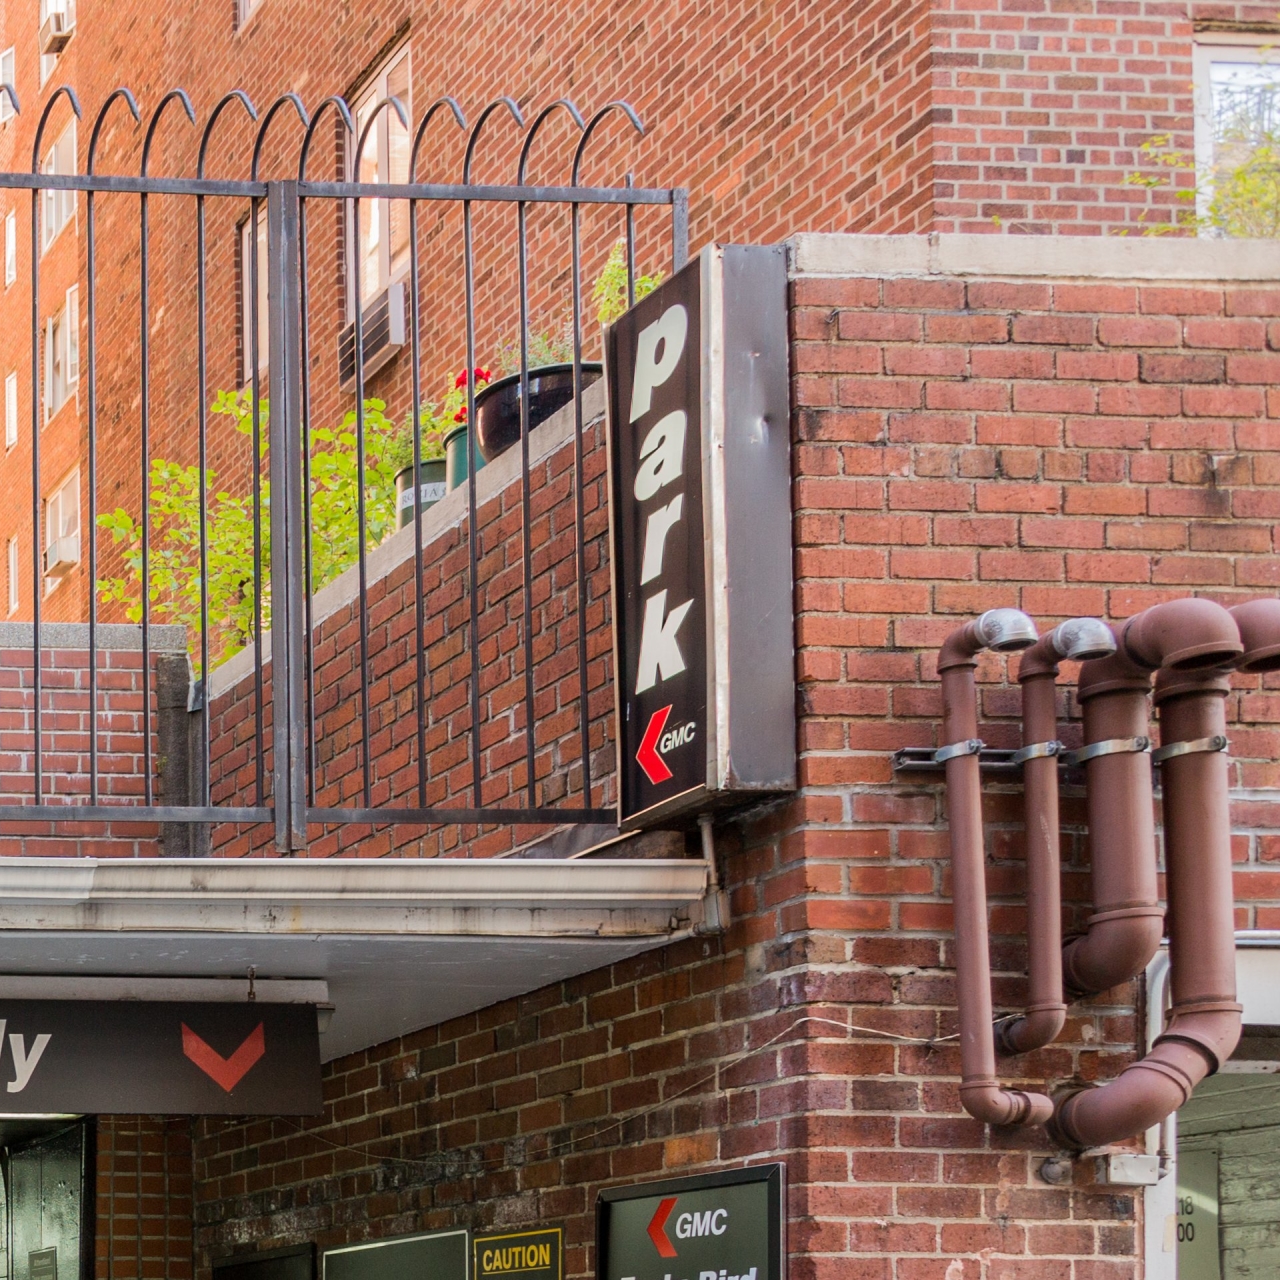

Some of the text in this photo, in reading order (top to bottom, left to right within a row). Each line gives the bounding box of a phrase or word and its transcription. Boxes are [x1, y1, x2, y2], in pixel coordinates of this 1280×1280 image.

[629, 303, 694, 695] park
[659, 721, 695, 755] GMC
[1177, 1196, 1194, 1215] .18
[675, 1208, 728, 1239] GMC
[482, 1244, 550, 1271] CAUTION
